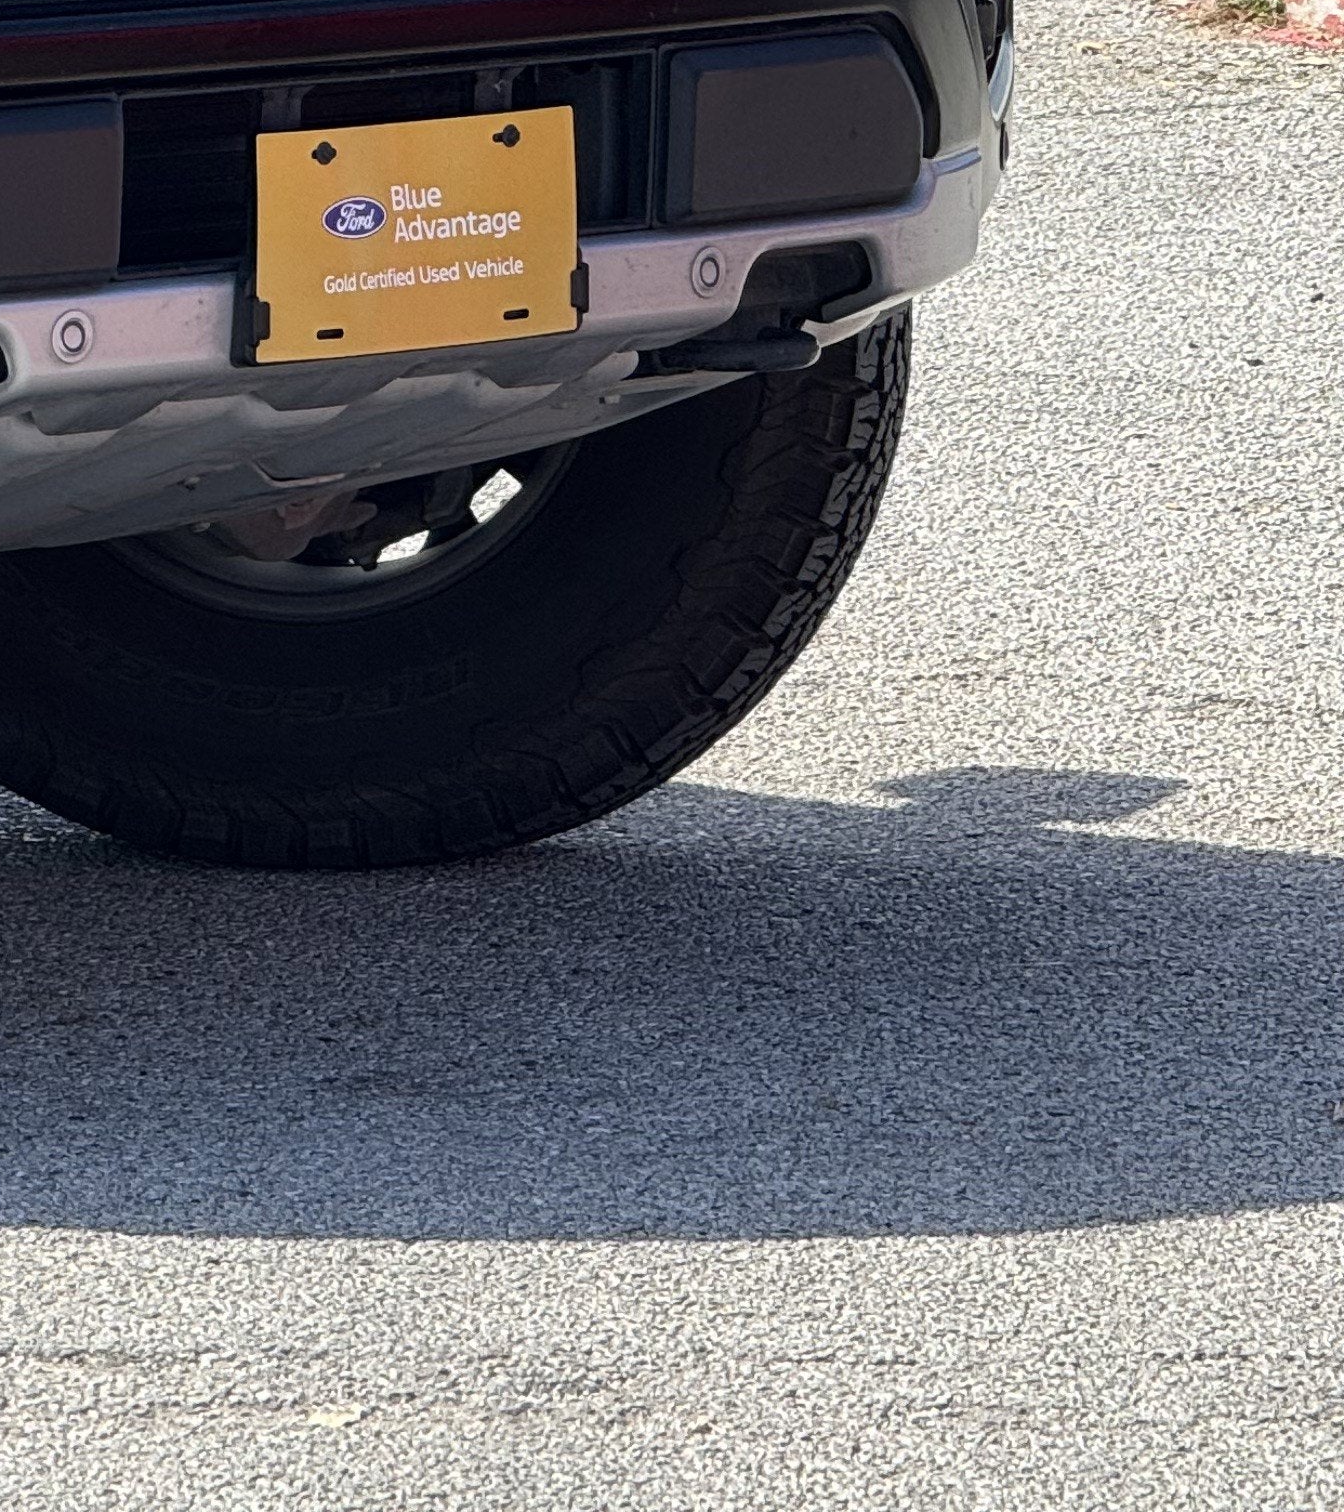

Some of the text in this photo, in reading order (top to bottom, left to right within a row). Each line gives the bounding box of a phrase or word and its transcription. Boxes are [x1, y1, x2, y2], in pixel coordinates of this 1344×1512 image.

[390, 183, 442, 211] Blue
[394, 210, 522, 243] Advantage
[323, 256, 524, 294] Gold Certified Used Vehicle
